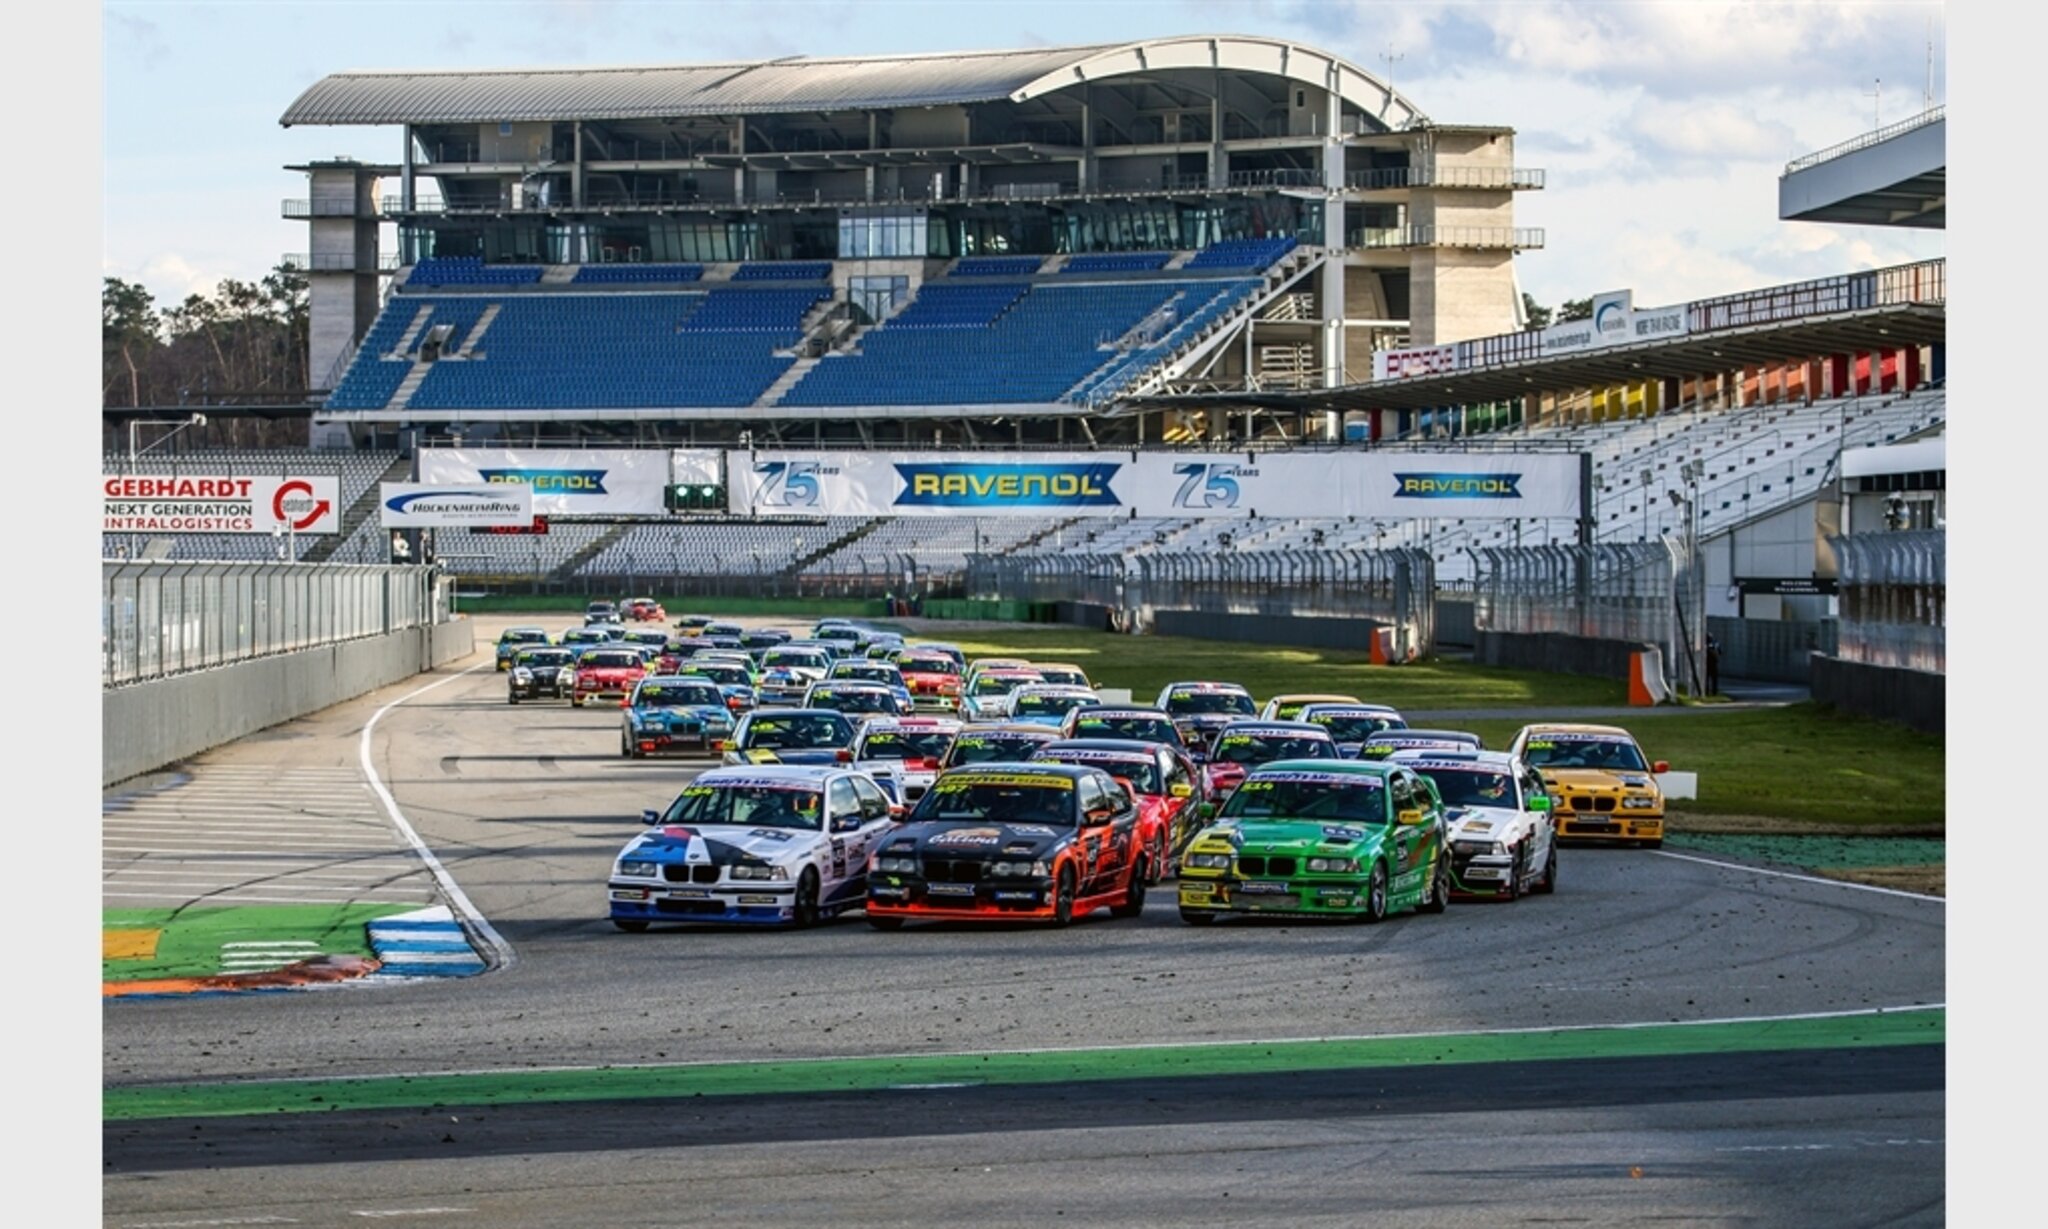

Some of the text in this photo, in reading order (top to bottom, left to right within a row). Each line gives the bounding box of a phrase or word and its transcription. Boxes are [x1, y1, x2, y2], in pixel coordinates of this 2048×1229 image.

[105, 480, 253, 497] GEBHARDT
[753, 461, 820, 507] 75
[914, 474, 1103, 496] RAVENOL
[1172, 463, 1260, 508] 75 YEARS
[1404, 479, 1512, 493] RAVENOL
[105, 504, 252, 516] NEXT GENERATION
[105, 517, 253, 529] INTRALOGISTICS
[943, 775, 1017, 785] GOODYEAR
[1250, 772, 1330, 780] GOODYEAR
